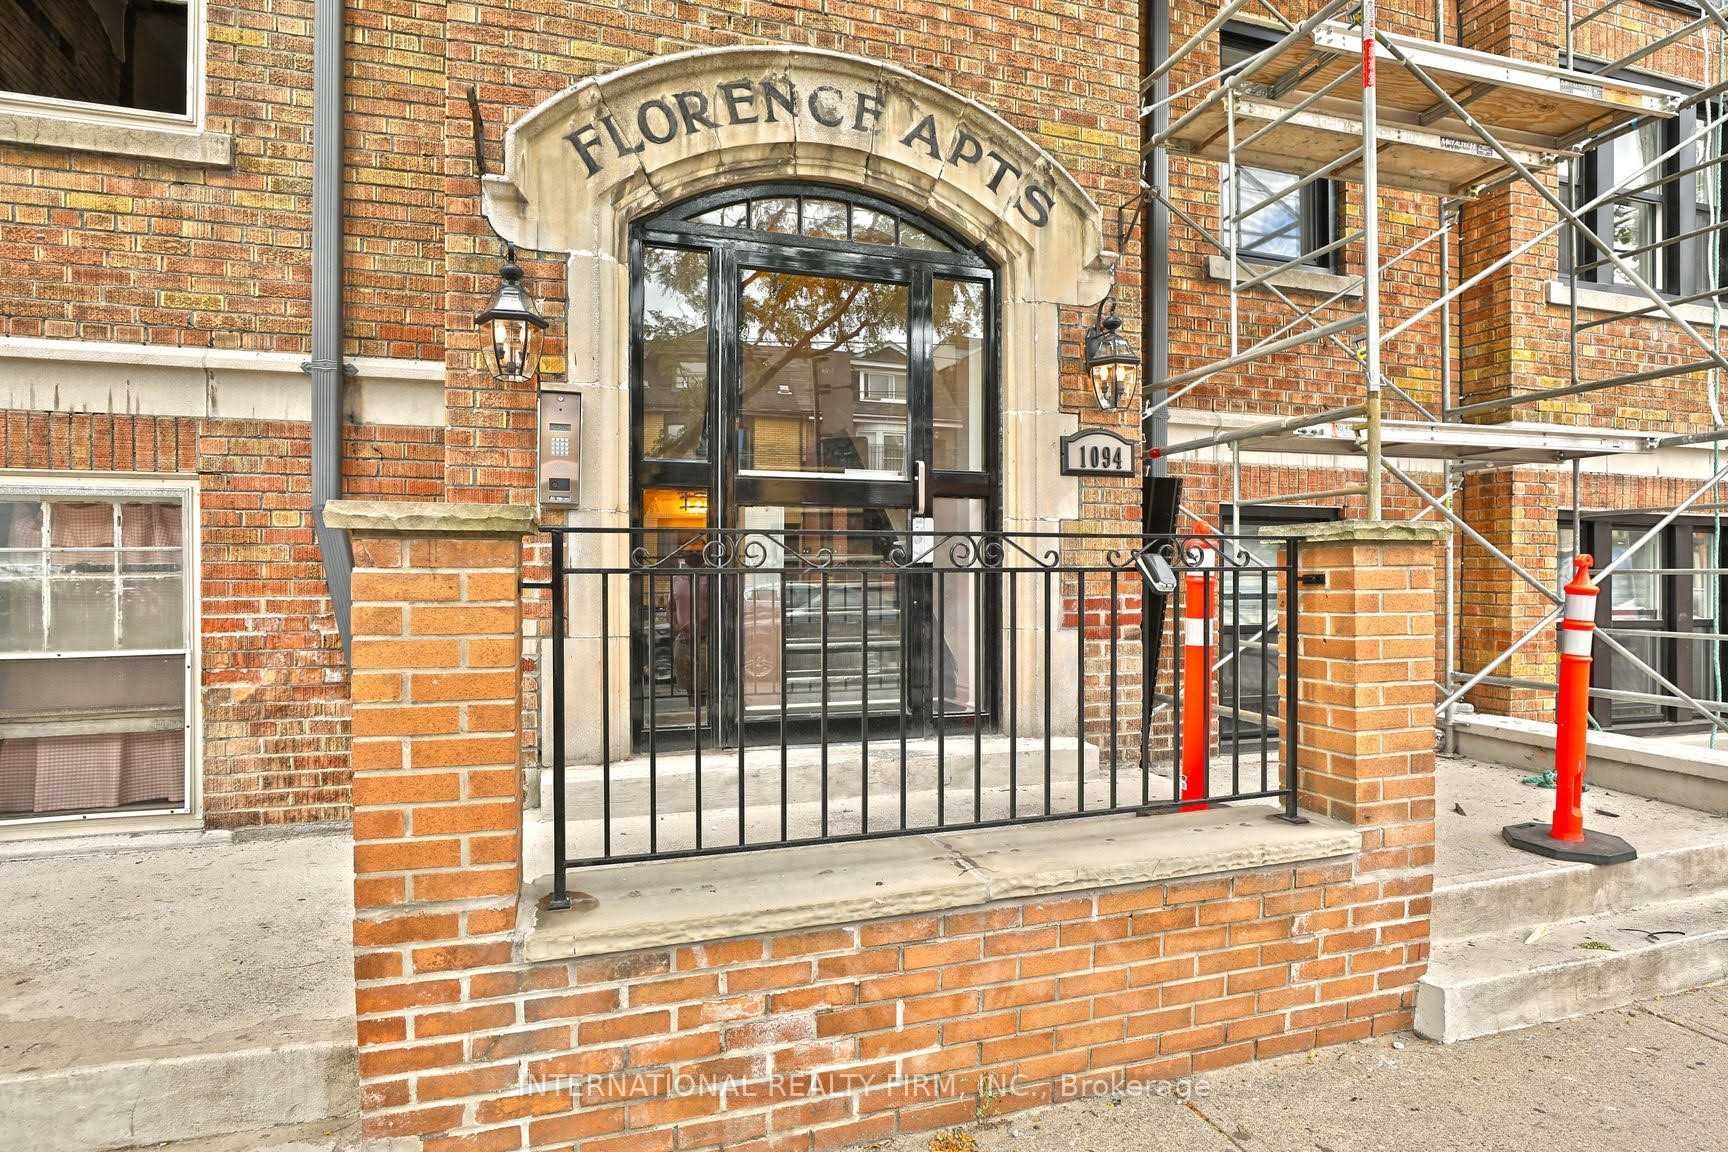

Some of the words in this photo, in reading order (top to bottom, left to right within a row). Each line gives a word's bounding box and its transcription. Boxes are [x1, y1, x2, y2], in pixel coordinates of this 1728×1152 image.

[562, 79, 886, 179] FLORENCE
[900, 114, 1056, 228] APTS
[1080, 445, 1122, 469] 1094
